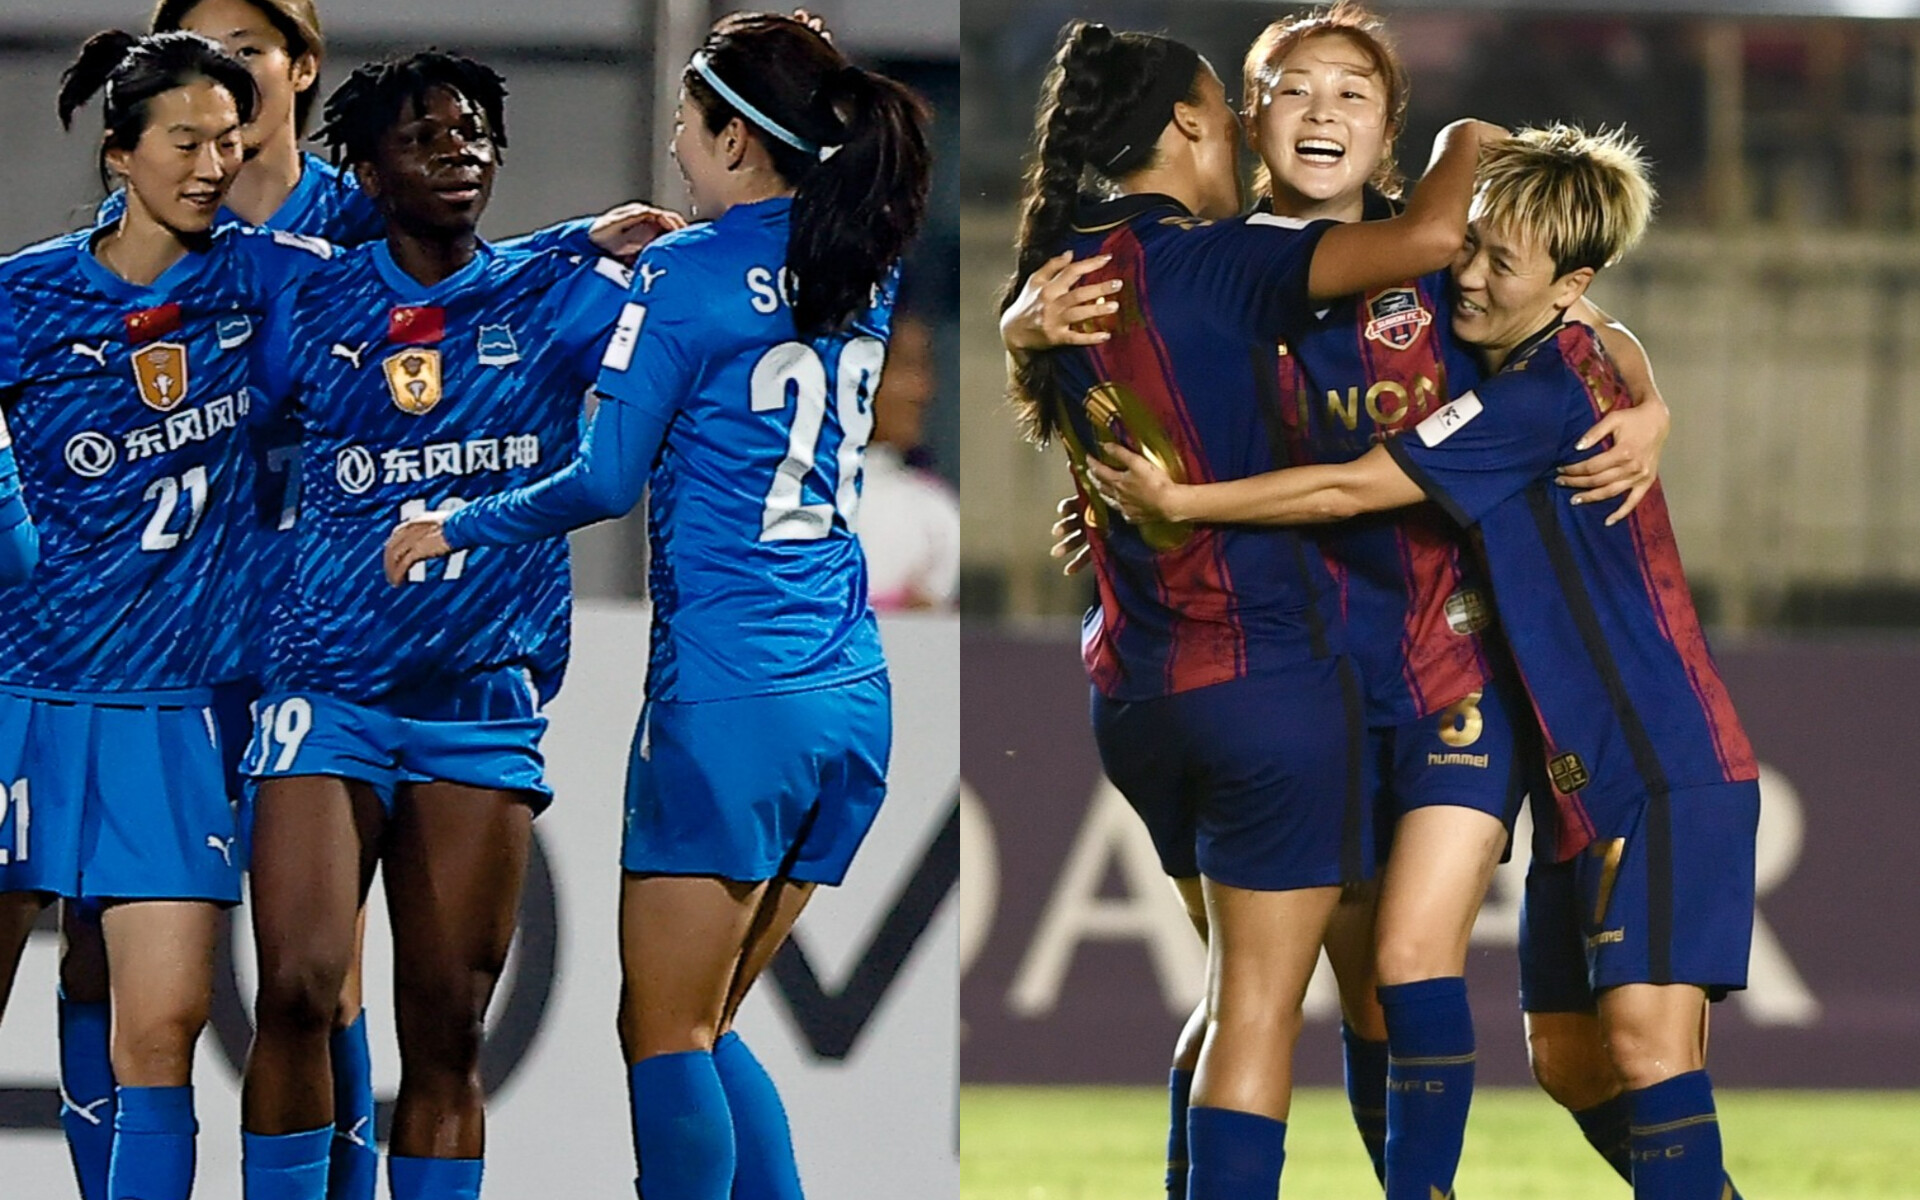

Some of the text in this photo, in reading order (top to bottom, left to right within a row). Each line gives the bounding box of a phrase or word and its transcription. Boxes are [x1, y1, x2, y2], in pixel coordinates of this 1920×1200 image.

[380, 433, 539, 484] 东风风神
[750, 338, 887, 542] 28
[141, 465, 208, 551] 21
[250, 697, 312, 776] 19
[1428, 753, 1489, 768] hummel
